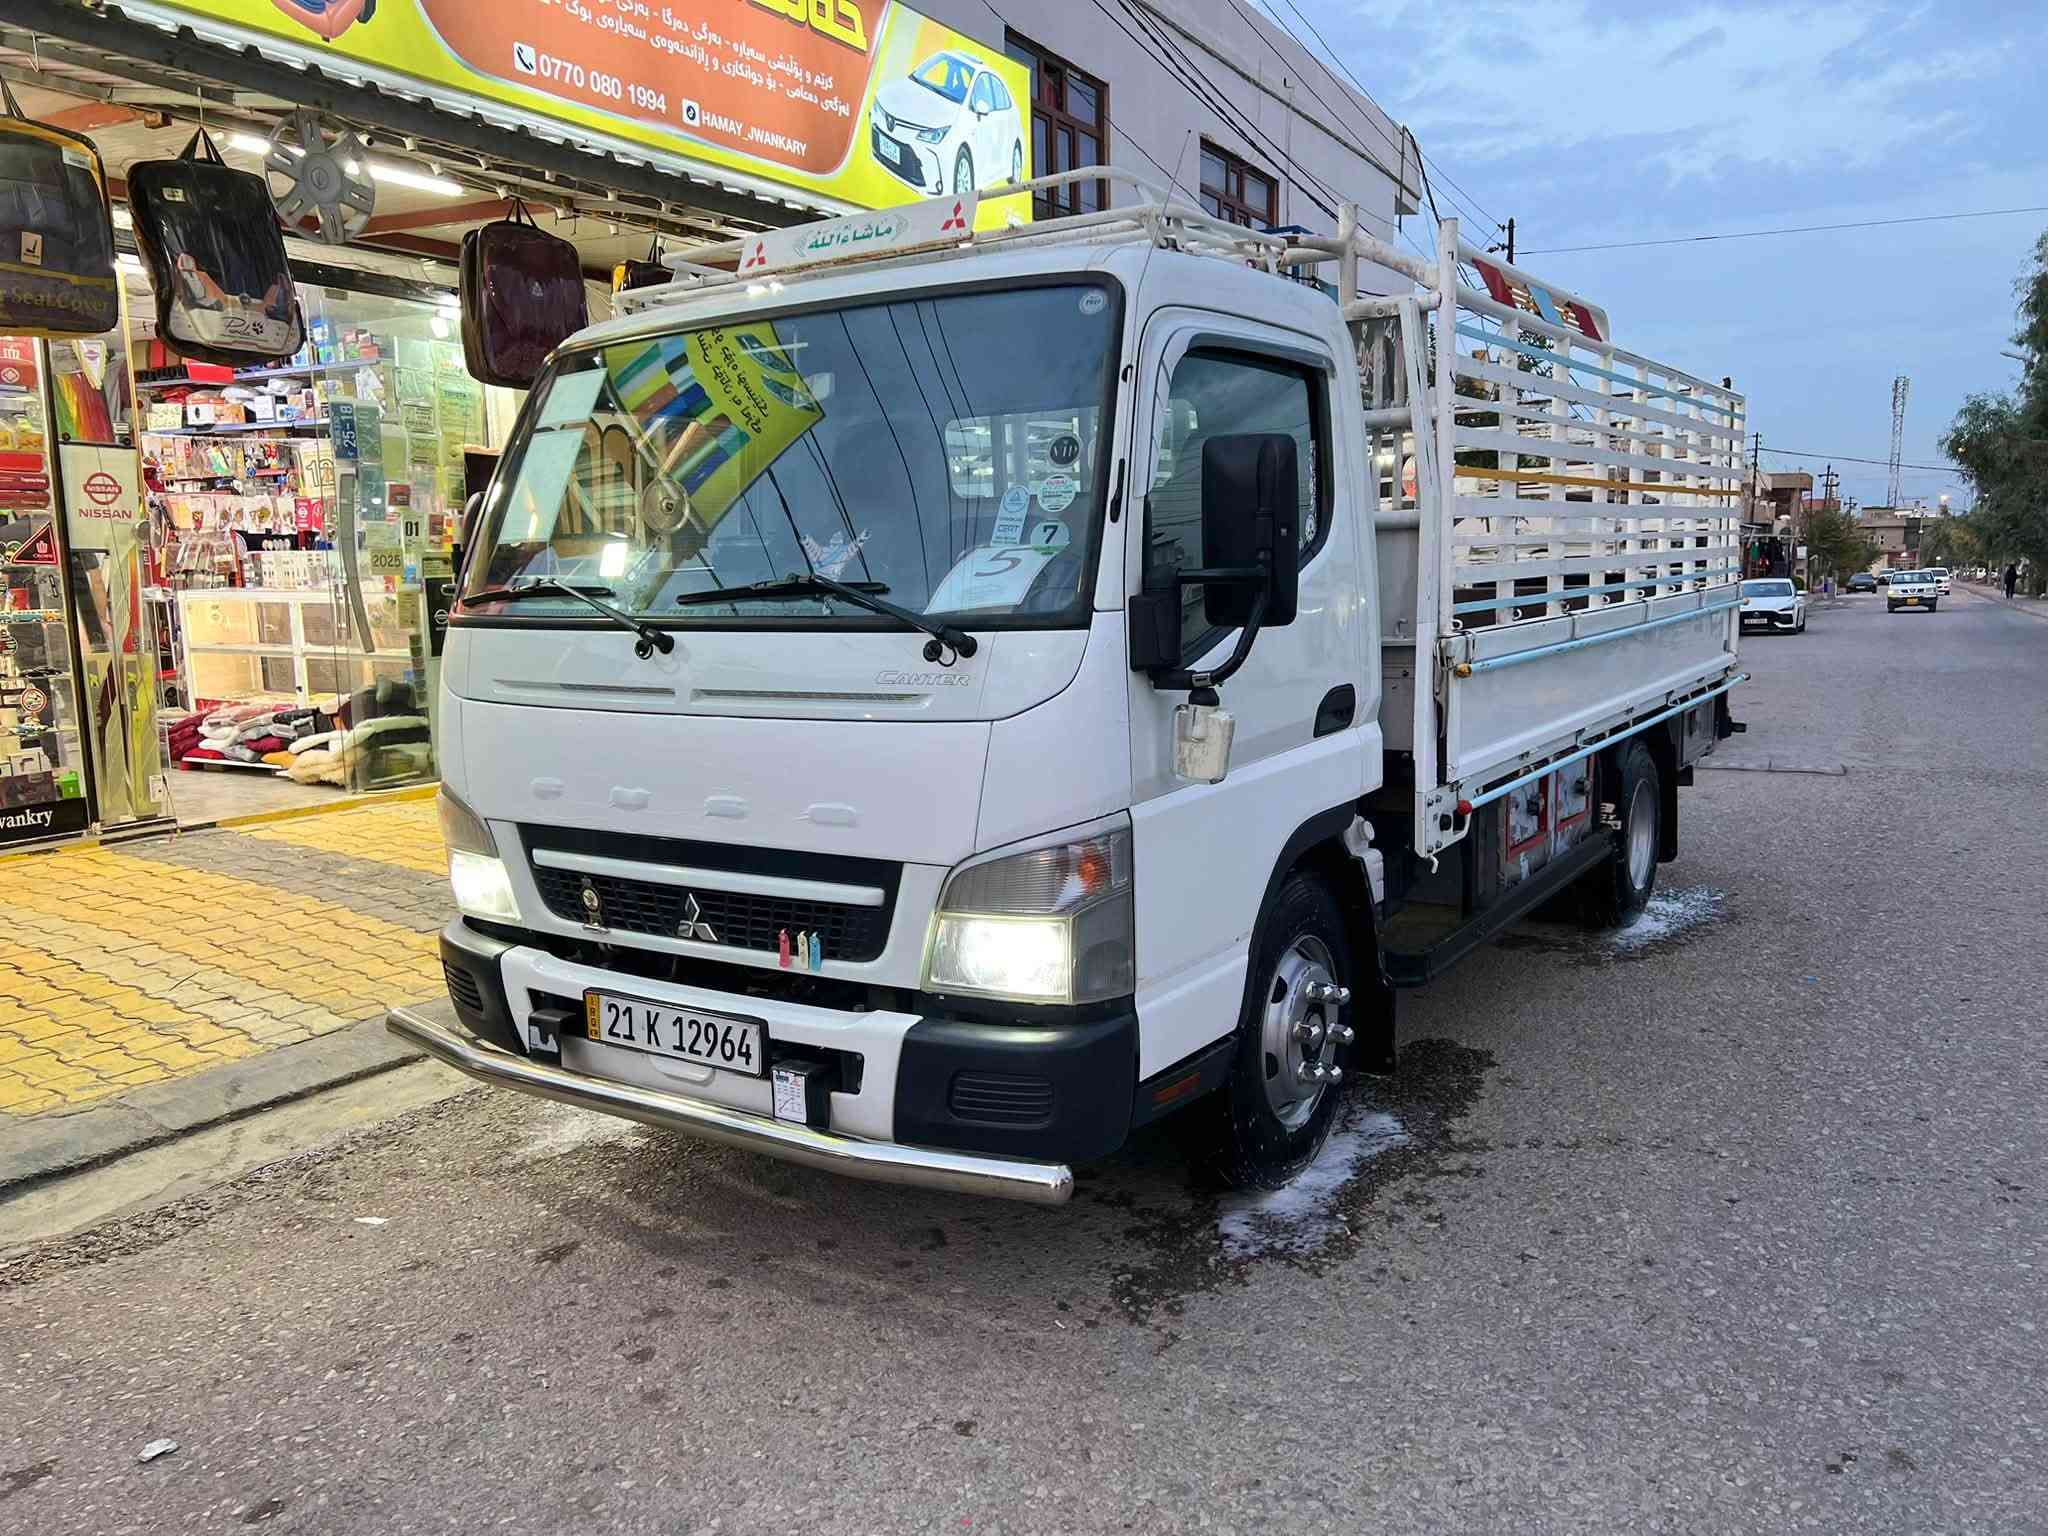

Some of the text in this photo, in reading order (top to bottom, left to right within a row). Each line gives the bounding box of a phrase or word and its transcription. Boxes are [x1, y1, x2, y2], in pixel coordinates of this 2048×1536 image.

[539, 54, 667, 114] 0770 080 1994
[701, 110, 807, 157] HAMAY_JWANKARY
[79, 508, 132, 519] NISSAN
[1042, 525, 1058, 545] 7
[371, 554, 400, 568] 2025
[974, 546, 1032, 577] 5
[607, 1003, 752, 1065] 21 K 12964
